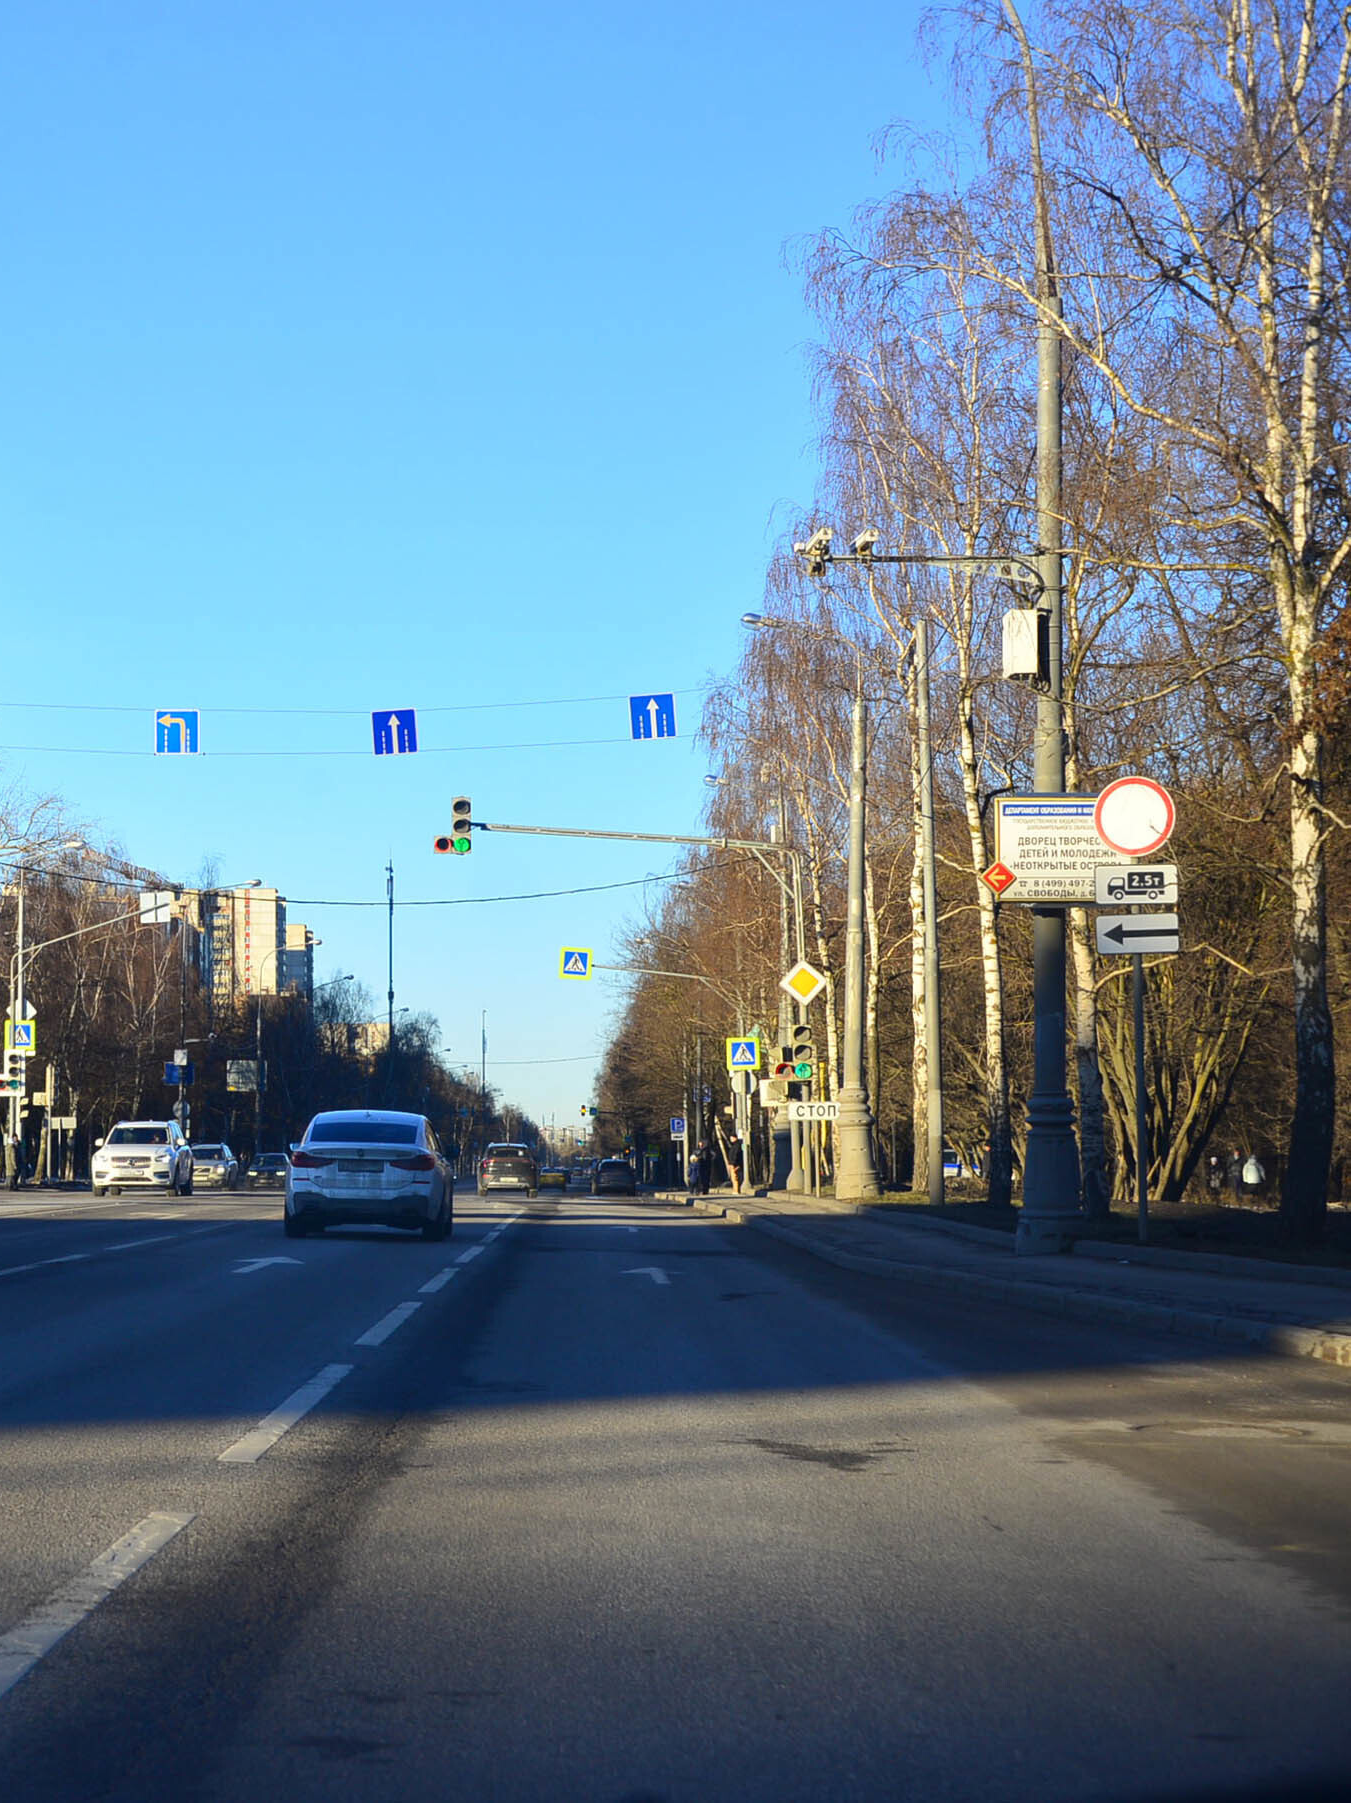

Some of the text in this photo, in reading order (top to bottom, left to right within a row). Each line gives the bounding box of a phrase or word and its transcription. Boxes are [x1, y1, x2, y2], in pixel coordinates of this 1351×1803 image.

[1018, 837, 1056, 847] ДВОРЕЦ
[1019, 847, 1049, 858] ДЕТЕЙ
[1052, 849, 1058, 858] И
[1042, 880, 1066, 888] (499)
[796, 1105, 836, 1117] СТОП
